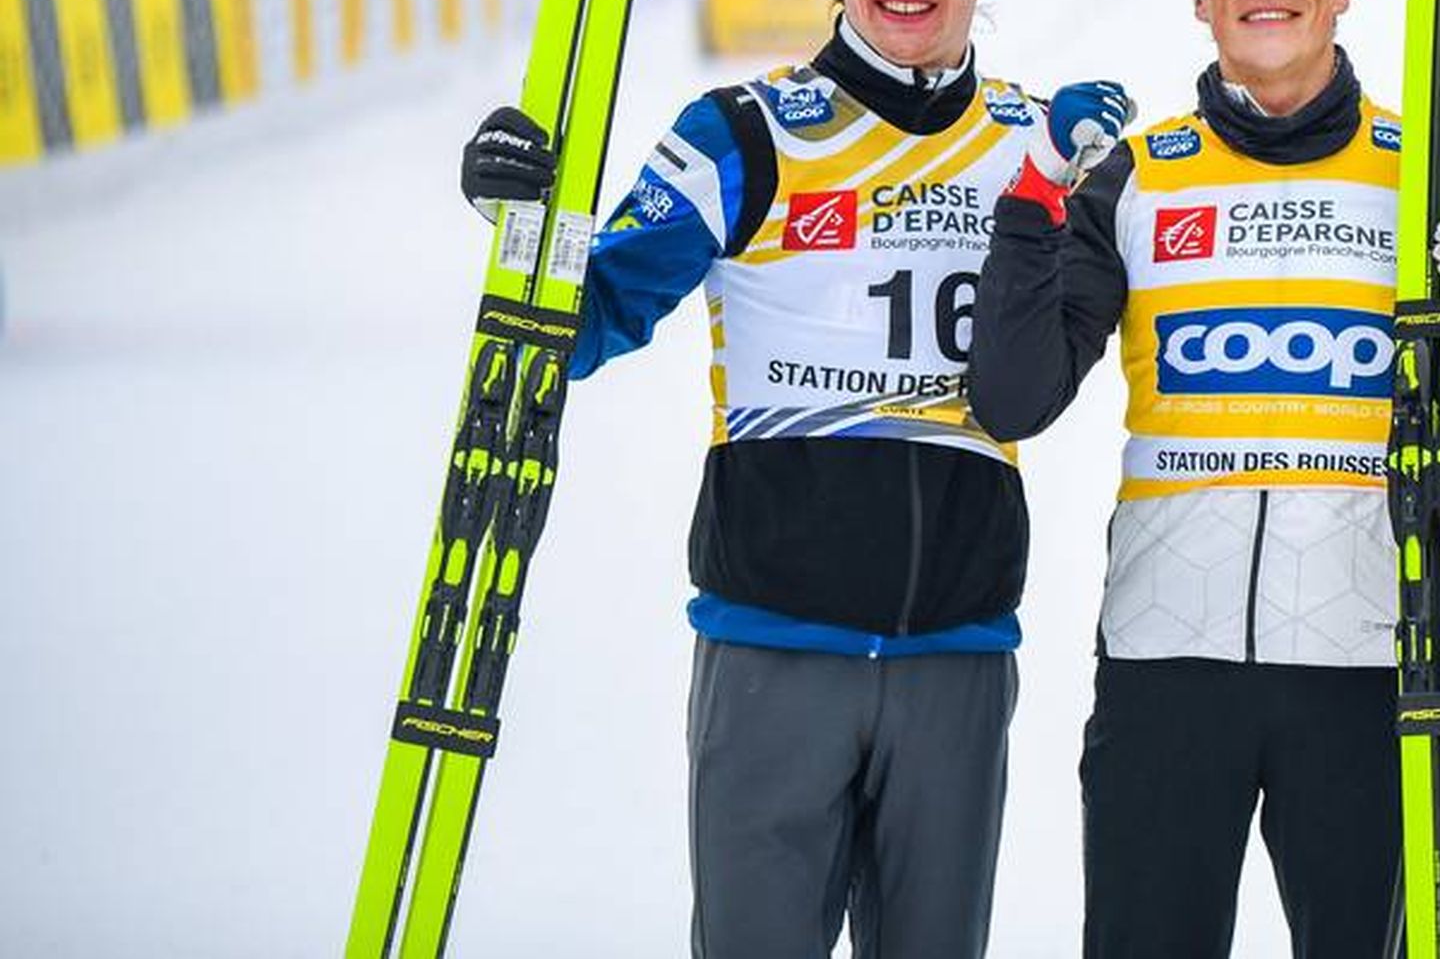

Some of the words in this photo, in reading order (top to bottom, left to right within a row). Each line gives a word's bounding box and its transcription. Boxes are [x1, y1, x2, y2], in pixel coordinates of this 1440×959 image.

[871, 183, 980, 209] CAISSE
[871, 210, 998, 236] D'EPARG
[1229, 200, 1335, 222] CAISSE
[871, 236, 956, 251] Bourgogne
[1228, 224, 1394, 250] D'EPARGNE
[1226, 244, 1308, 259] Bourgogne
[484, 310, 577, 338] FISCHER
[868, 269, 980, 363] 16
[1164, 320, 1395, 388] coop
[768, 360, 887, 394] STATION
[897, 373, 948, 396] DES
[1157, 451, 1236, 472] STATION
[1243, 452, 1289, 472] DES
